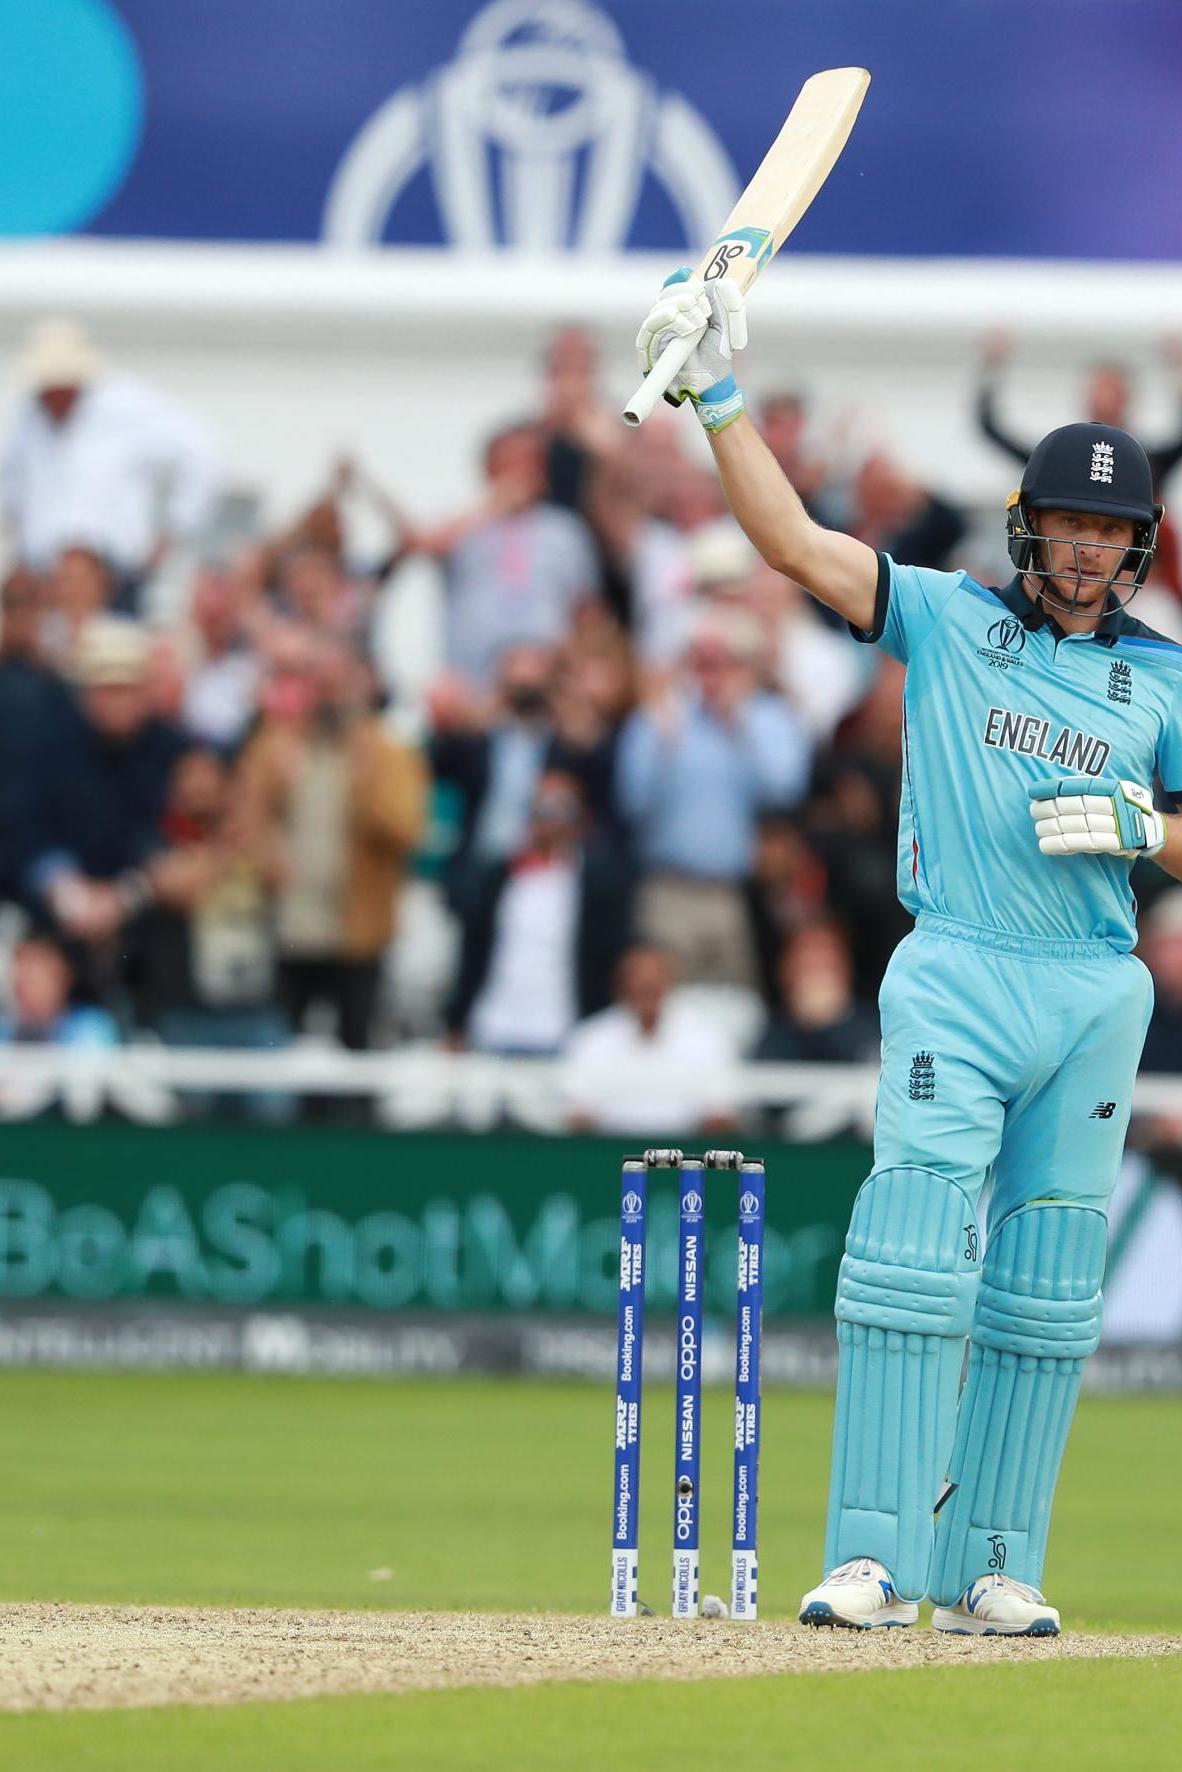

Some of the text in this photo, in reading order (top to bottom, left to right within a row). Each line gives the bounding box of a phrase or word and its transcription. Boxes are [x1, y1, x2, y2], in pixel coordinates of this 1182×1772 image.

[988, 658, 1009, 670] 2019
[983, 706, 1112, 777] ENGLAND
[620, 1236, 632, 1292] MRF
[632, 1243, 642, 1286] TYRES
[685, 1235, 697, 1302] NISSAN
[737, 1236, 749, 1292] MRF
[749, 1243, 759, 1286] TYRES
[621, 1305, 635, 1381] Booking.com
[680, 1315, 697, 1381] oppo
[738, 1306, 753, 1382] Booking.com
[616, 1395, 627, 1451] MRF
[627, 1402, 638, 1444] TYRES
[681, 1395, 694, 1461] NISSAN
[735, 1396, 745, 1452] MRF
[745, 1403, 756, 1444] TYRES
[616, 1464, 631, 1540] Booking.com
[735, 1465, 749, 1541] Booking.com
